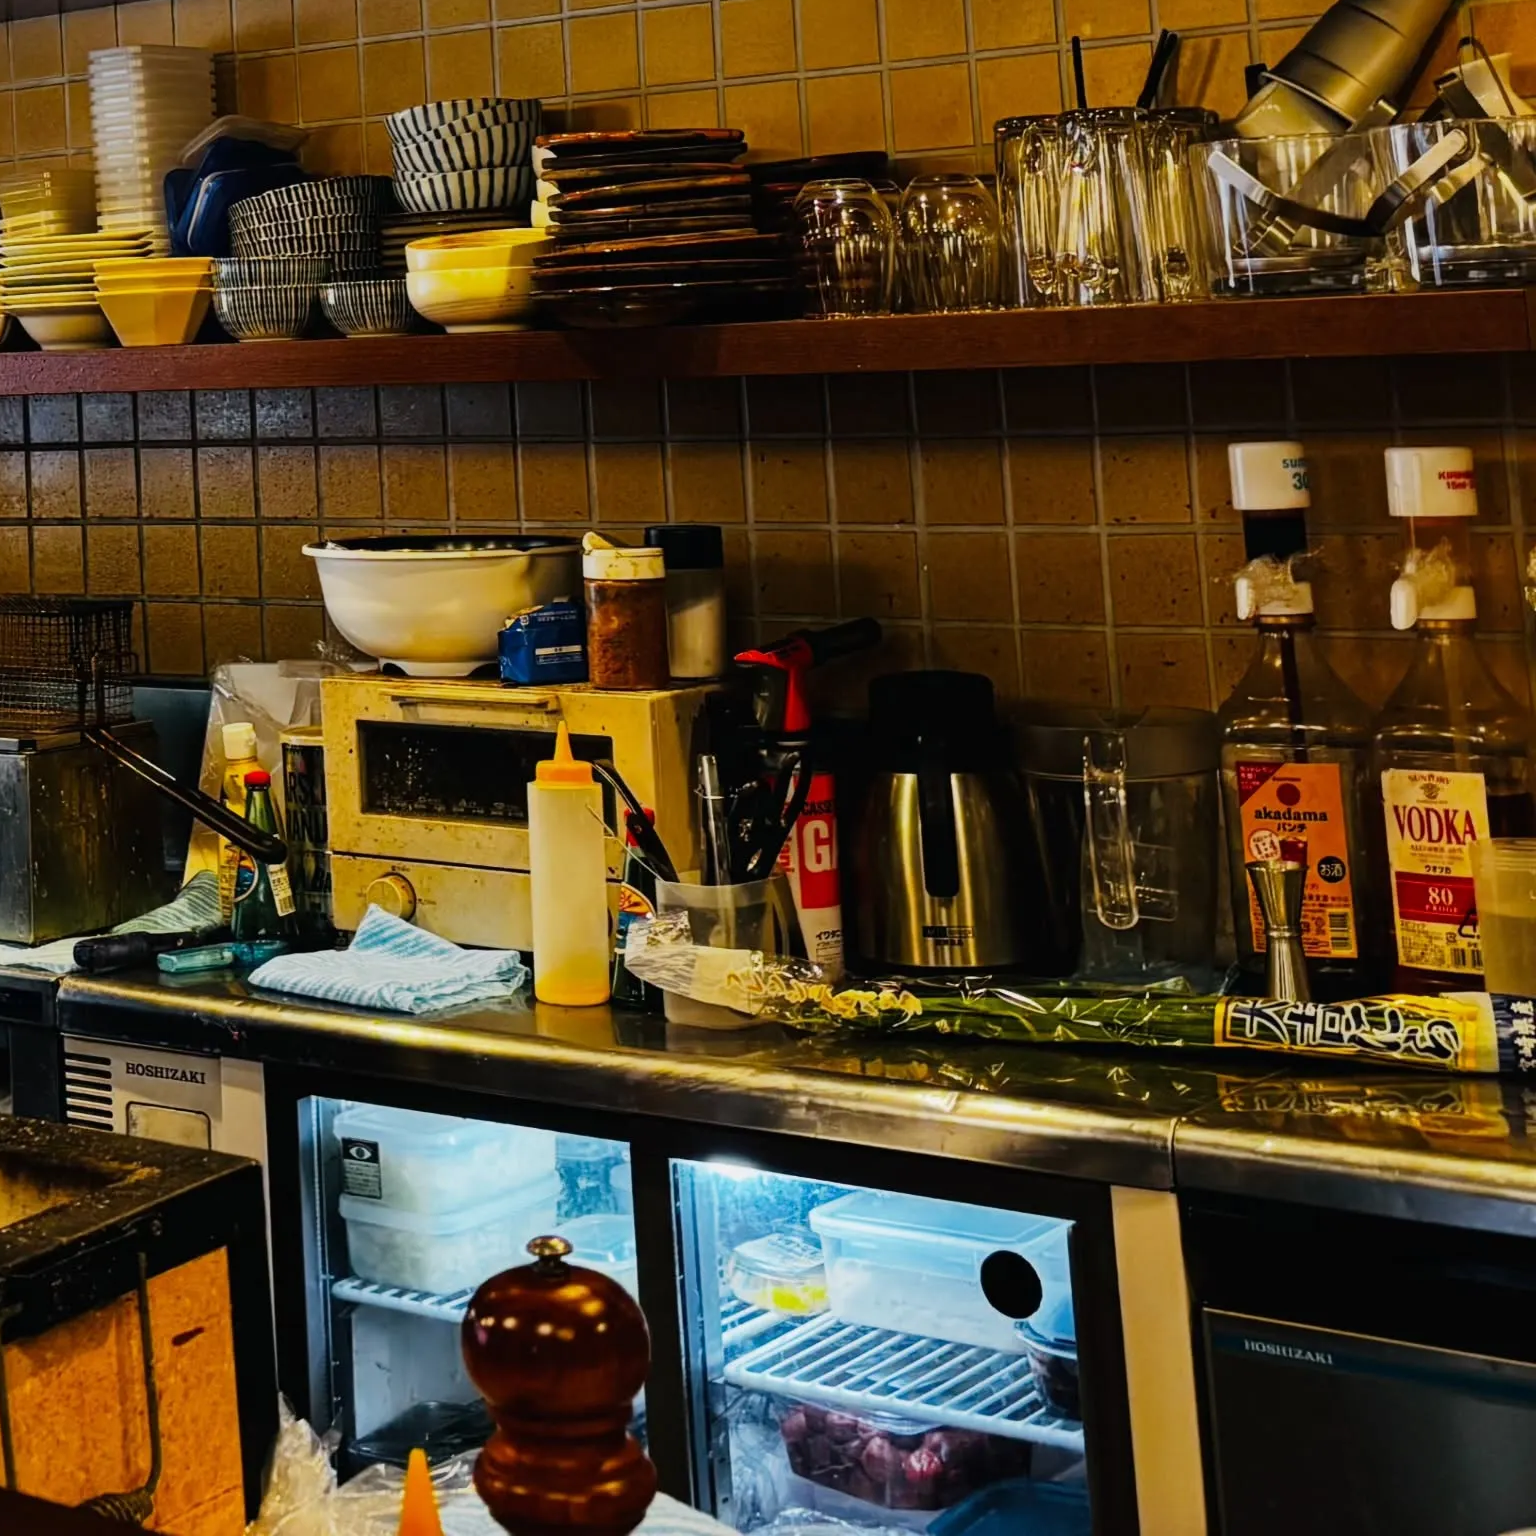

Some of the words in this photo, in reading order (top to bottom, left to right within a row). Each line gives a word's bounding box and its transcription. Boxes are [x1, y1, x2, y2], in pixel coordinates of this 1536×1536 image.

[1254, 805, 1328, 822] akadama
[1276, 822, 1308, 833] パンチ
[1392, 804, 1478, 846] VODKA
[1319, 863, 1343, 877] お酒
[1428, 886, 1454, 906] 80
[125, 1061, 207, 1085] HOSHIZAKI
[1244, 1338, 1334, 1366] HOSHIZAKI
